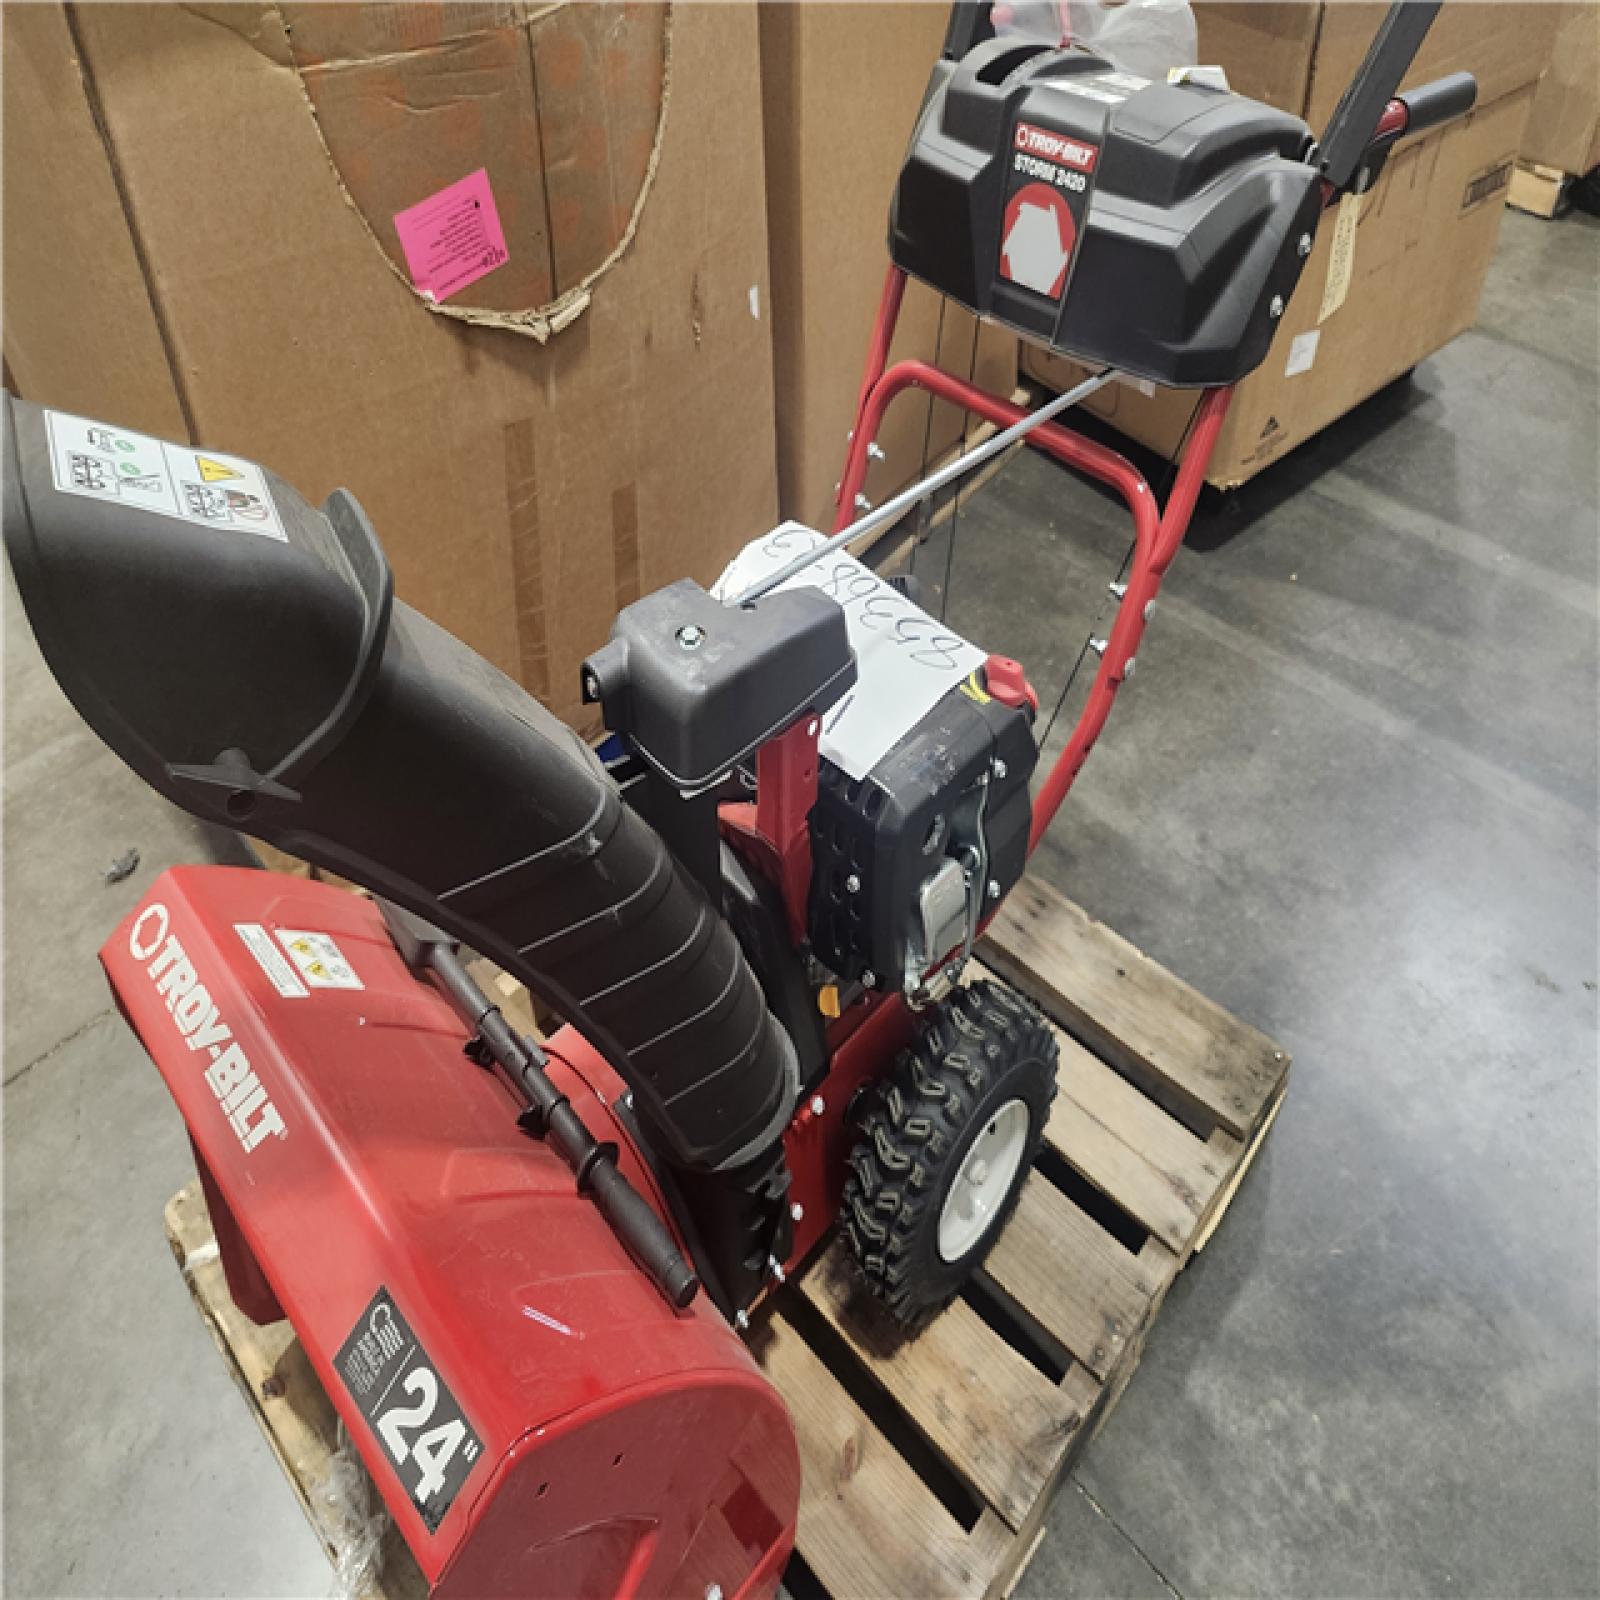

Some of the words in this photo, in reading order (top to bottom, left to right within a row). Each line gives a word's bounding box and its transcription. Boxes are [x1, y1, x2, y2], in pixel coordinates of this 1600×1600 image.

[1029, 131, 1093, 166] TROY-BILT
[1013, 153, 1056, 182] STORM
[147, 933, 287, 1153] TROY-BILT
